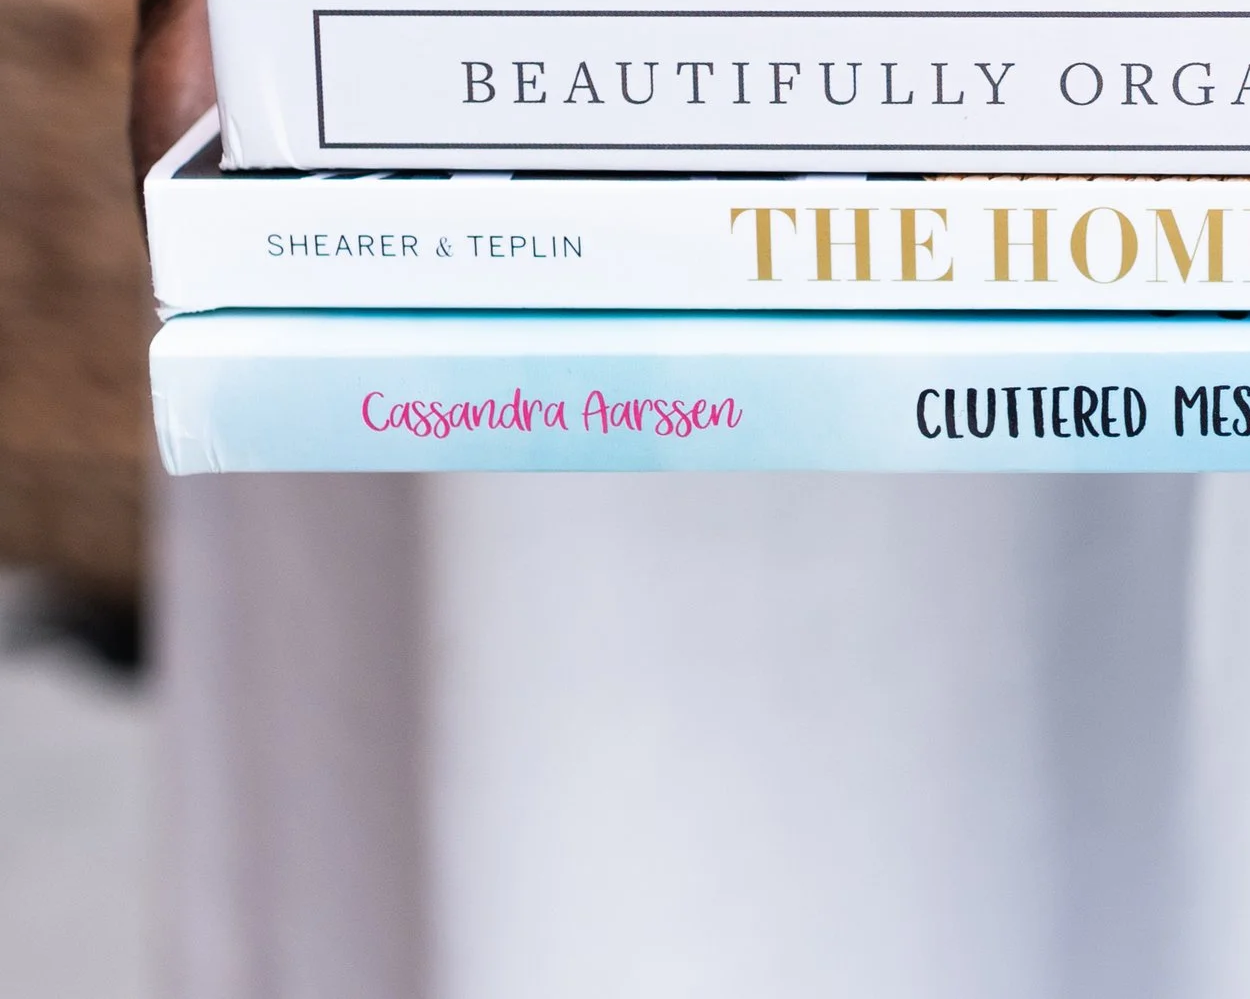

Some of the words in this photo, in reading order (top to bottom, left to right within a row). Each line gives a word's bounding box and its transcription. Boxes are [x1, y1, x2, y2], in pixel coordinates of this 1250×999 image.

[460, 60, 1016, 106] BEAUTIFULLY
[267, 233, 419, 257] SHEARER
[435, 237, 454, 258] &
[466, 235, 583, 258] TEPLIN
[730, 207, 954, 283] THE
[361, 386, 569, 440] Cassandra
[581, 389, 743, 439] Aarssen
[916, 384, 1148, 440] CLUTTERED
